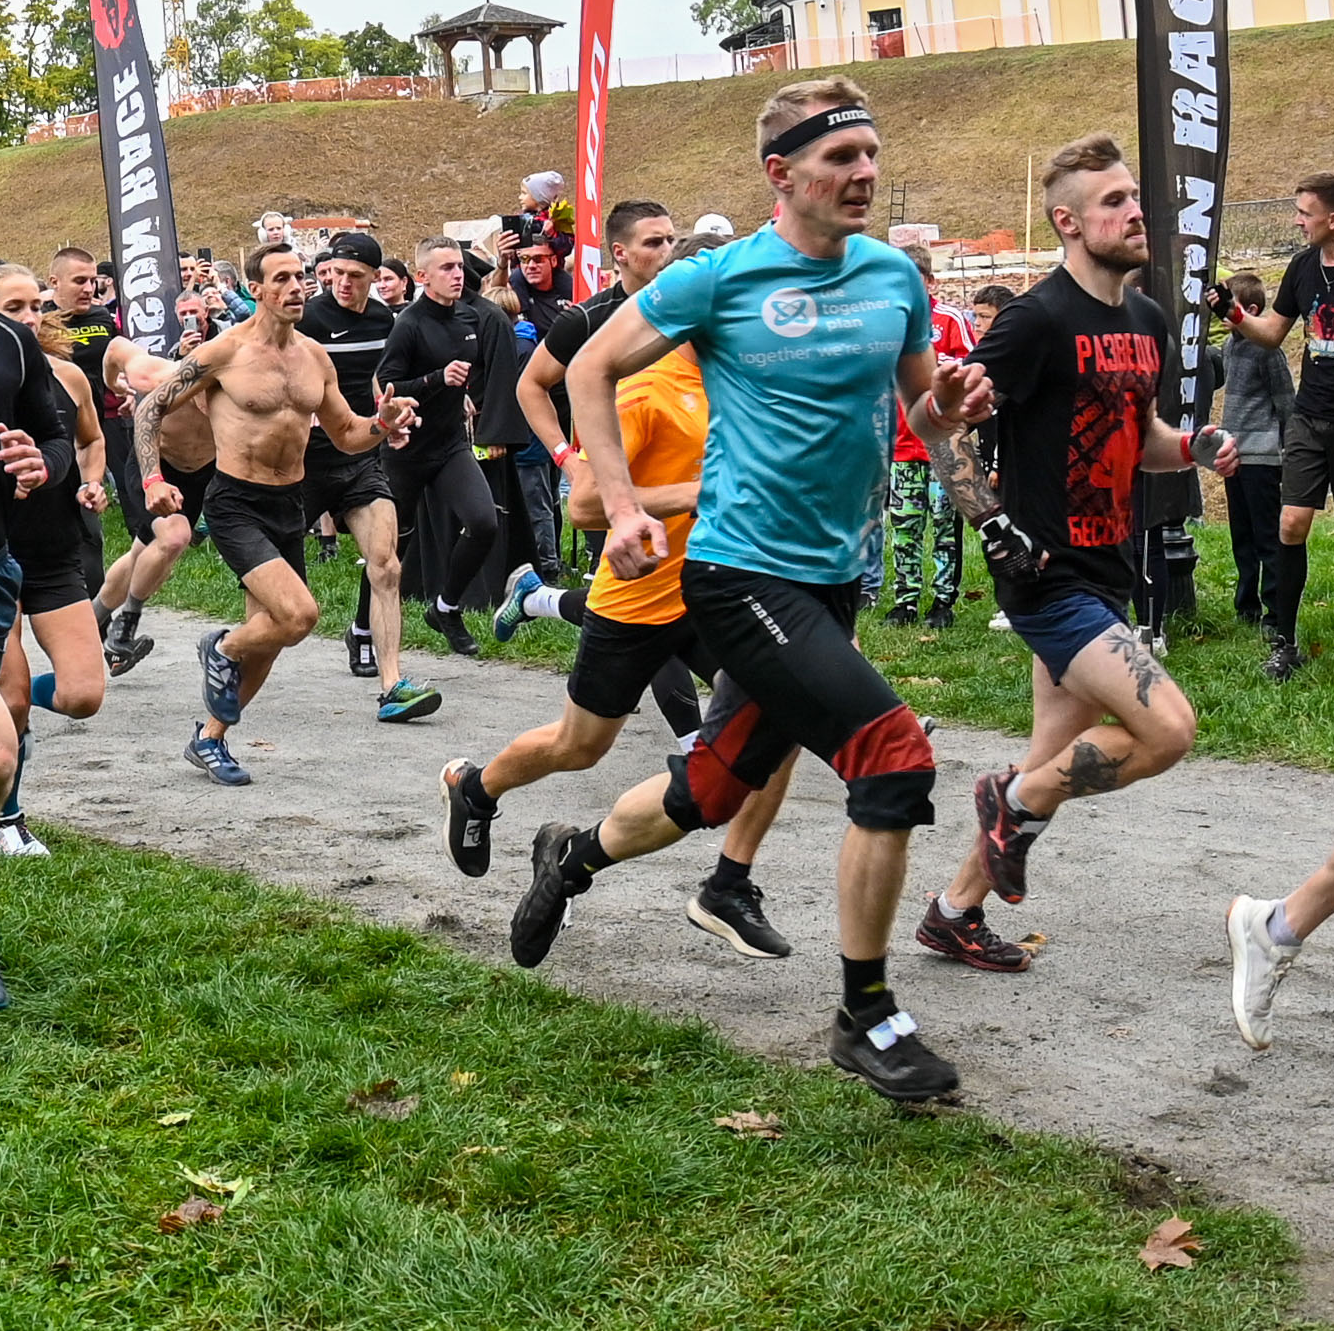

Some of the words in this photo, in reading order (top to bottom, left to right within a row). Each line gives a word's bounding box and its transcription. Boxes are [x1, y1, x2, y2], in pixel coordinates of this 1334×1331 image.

[822, 299, 891, 316] together
[827, 317, 863, 333] plan
[738, 343, 812, 367] together
